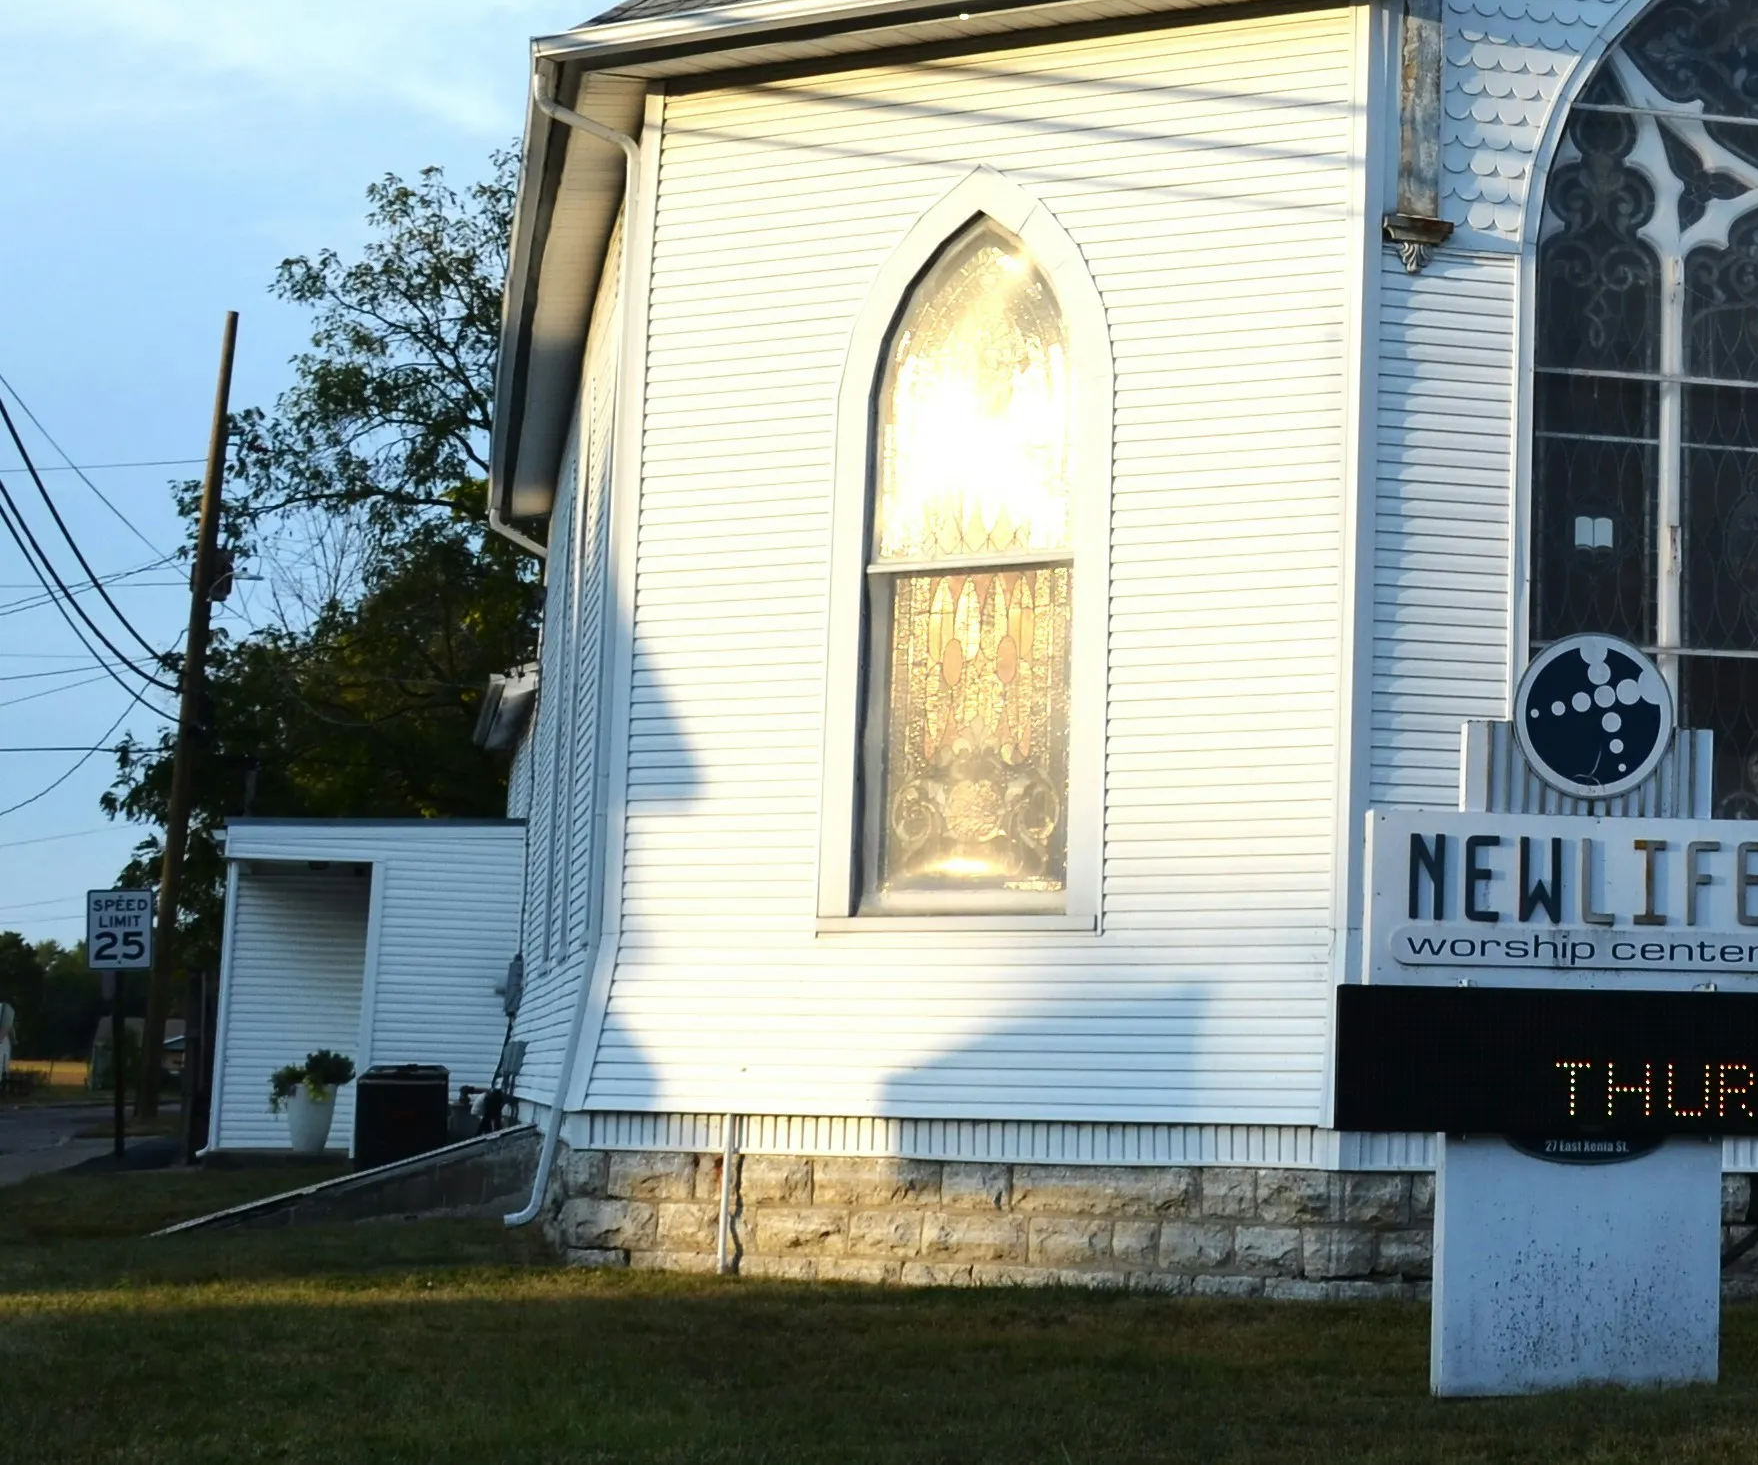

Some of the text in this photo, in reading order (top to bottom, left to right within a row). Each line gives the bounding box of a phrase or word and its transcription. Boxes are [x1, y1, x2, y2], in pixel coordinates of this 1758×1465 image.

[93, 899, 148, 912] SPEED
[99, 915, 142, 928] LIMIT
[94, 931, 145, 960] 25
[1406, 934, 1595, 965] worship
[1545, 1140, 1629, 1152] 27 East Xenia St.
